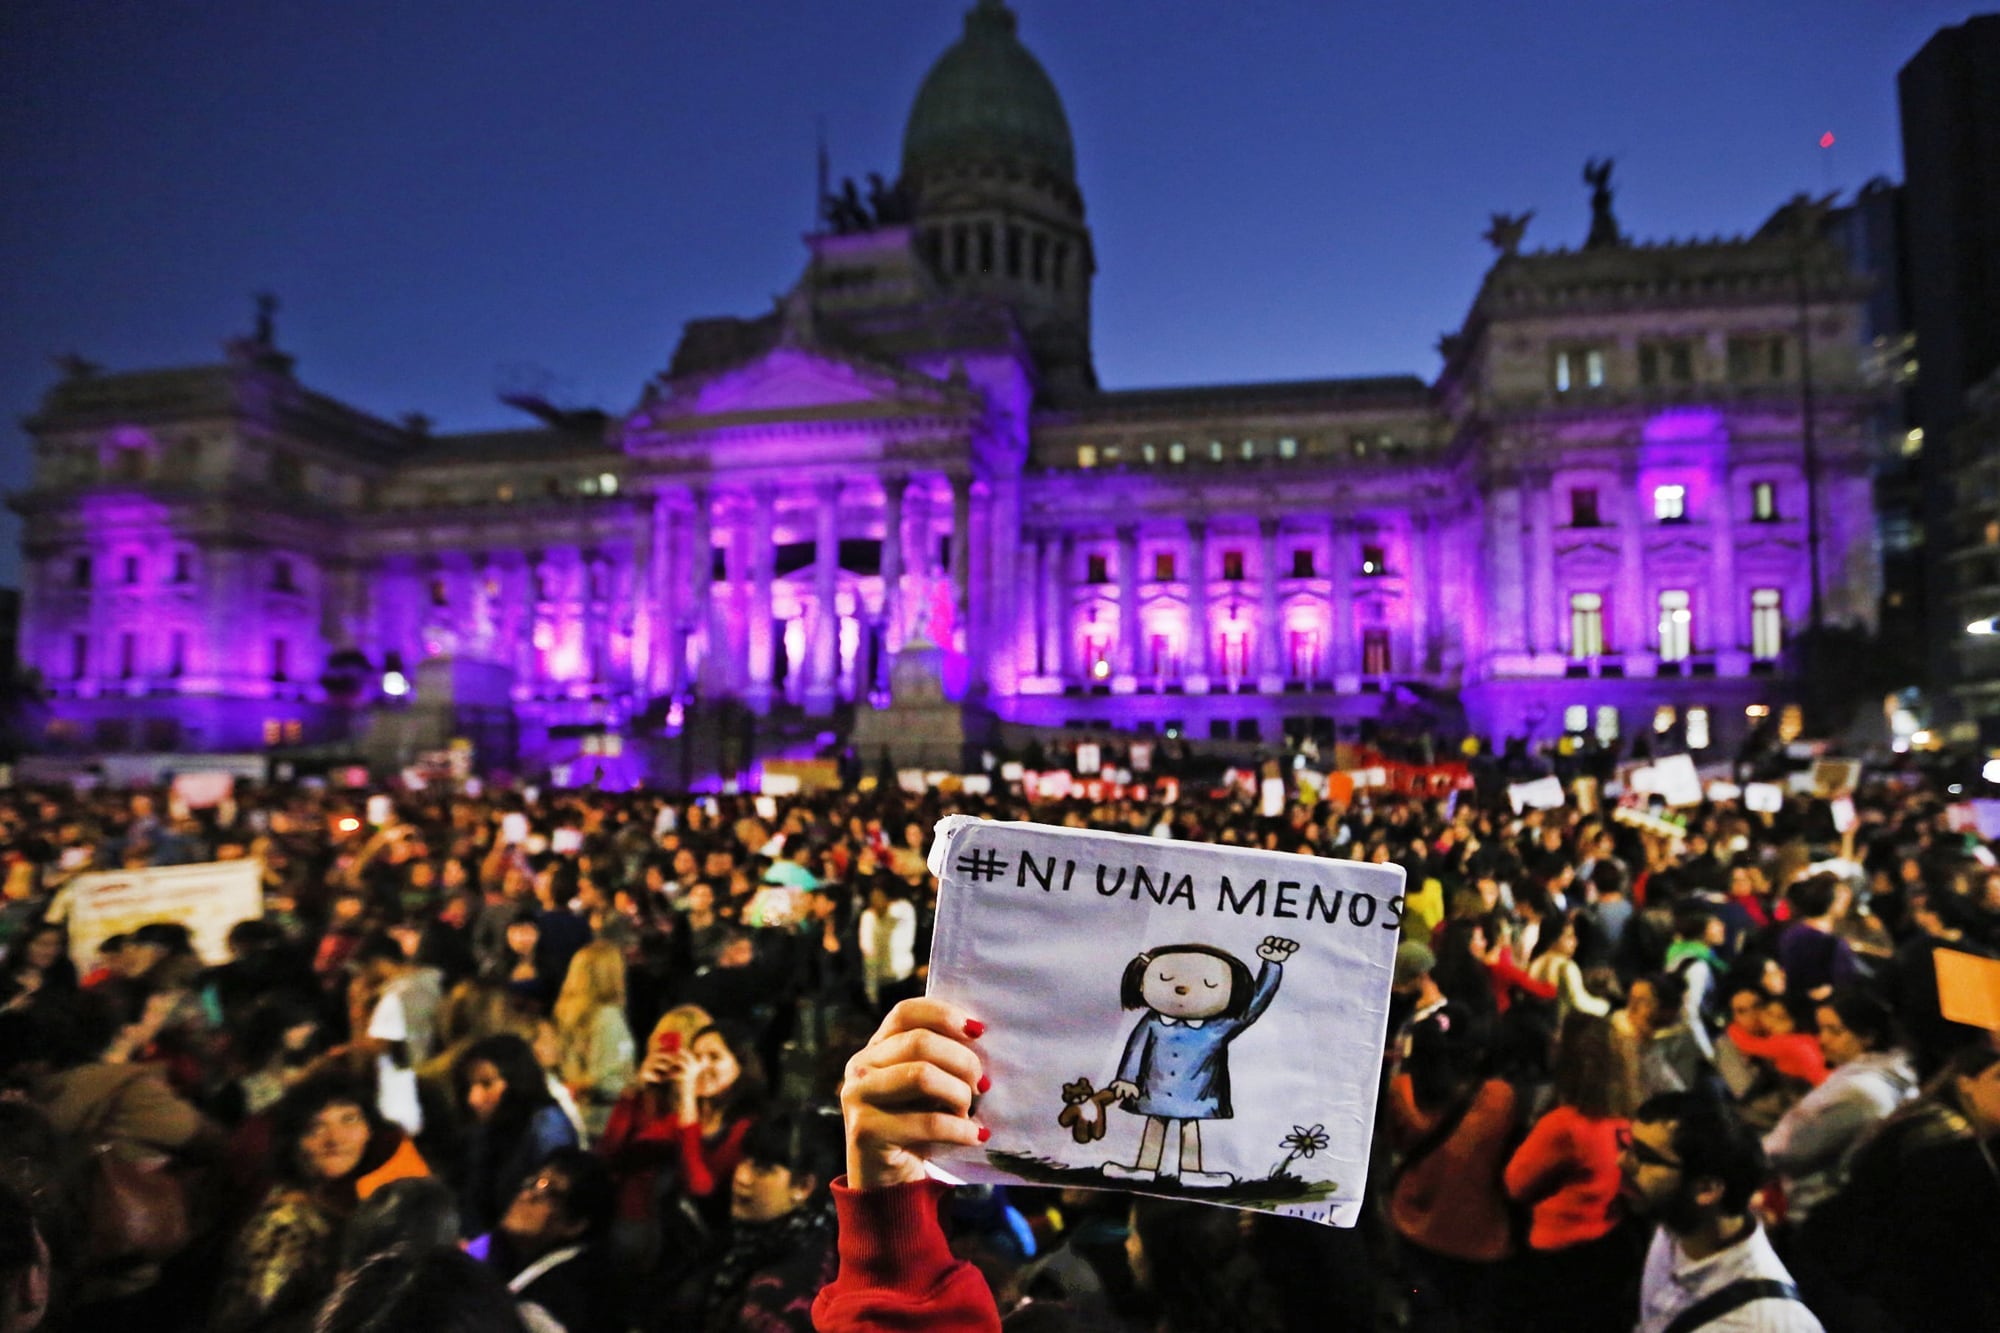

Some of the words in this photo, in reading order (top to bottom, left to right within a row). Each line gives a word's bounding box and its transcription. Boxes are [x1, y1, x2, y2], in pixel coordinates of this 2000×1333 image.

[956, 847, 1077, 892] #NI
[1096, 864, 1197, 912] UNA
[1217, 875, 1406, 931] MENOS
